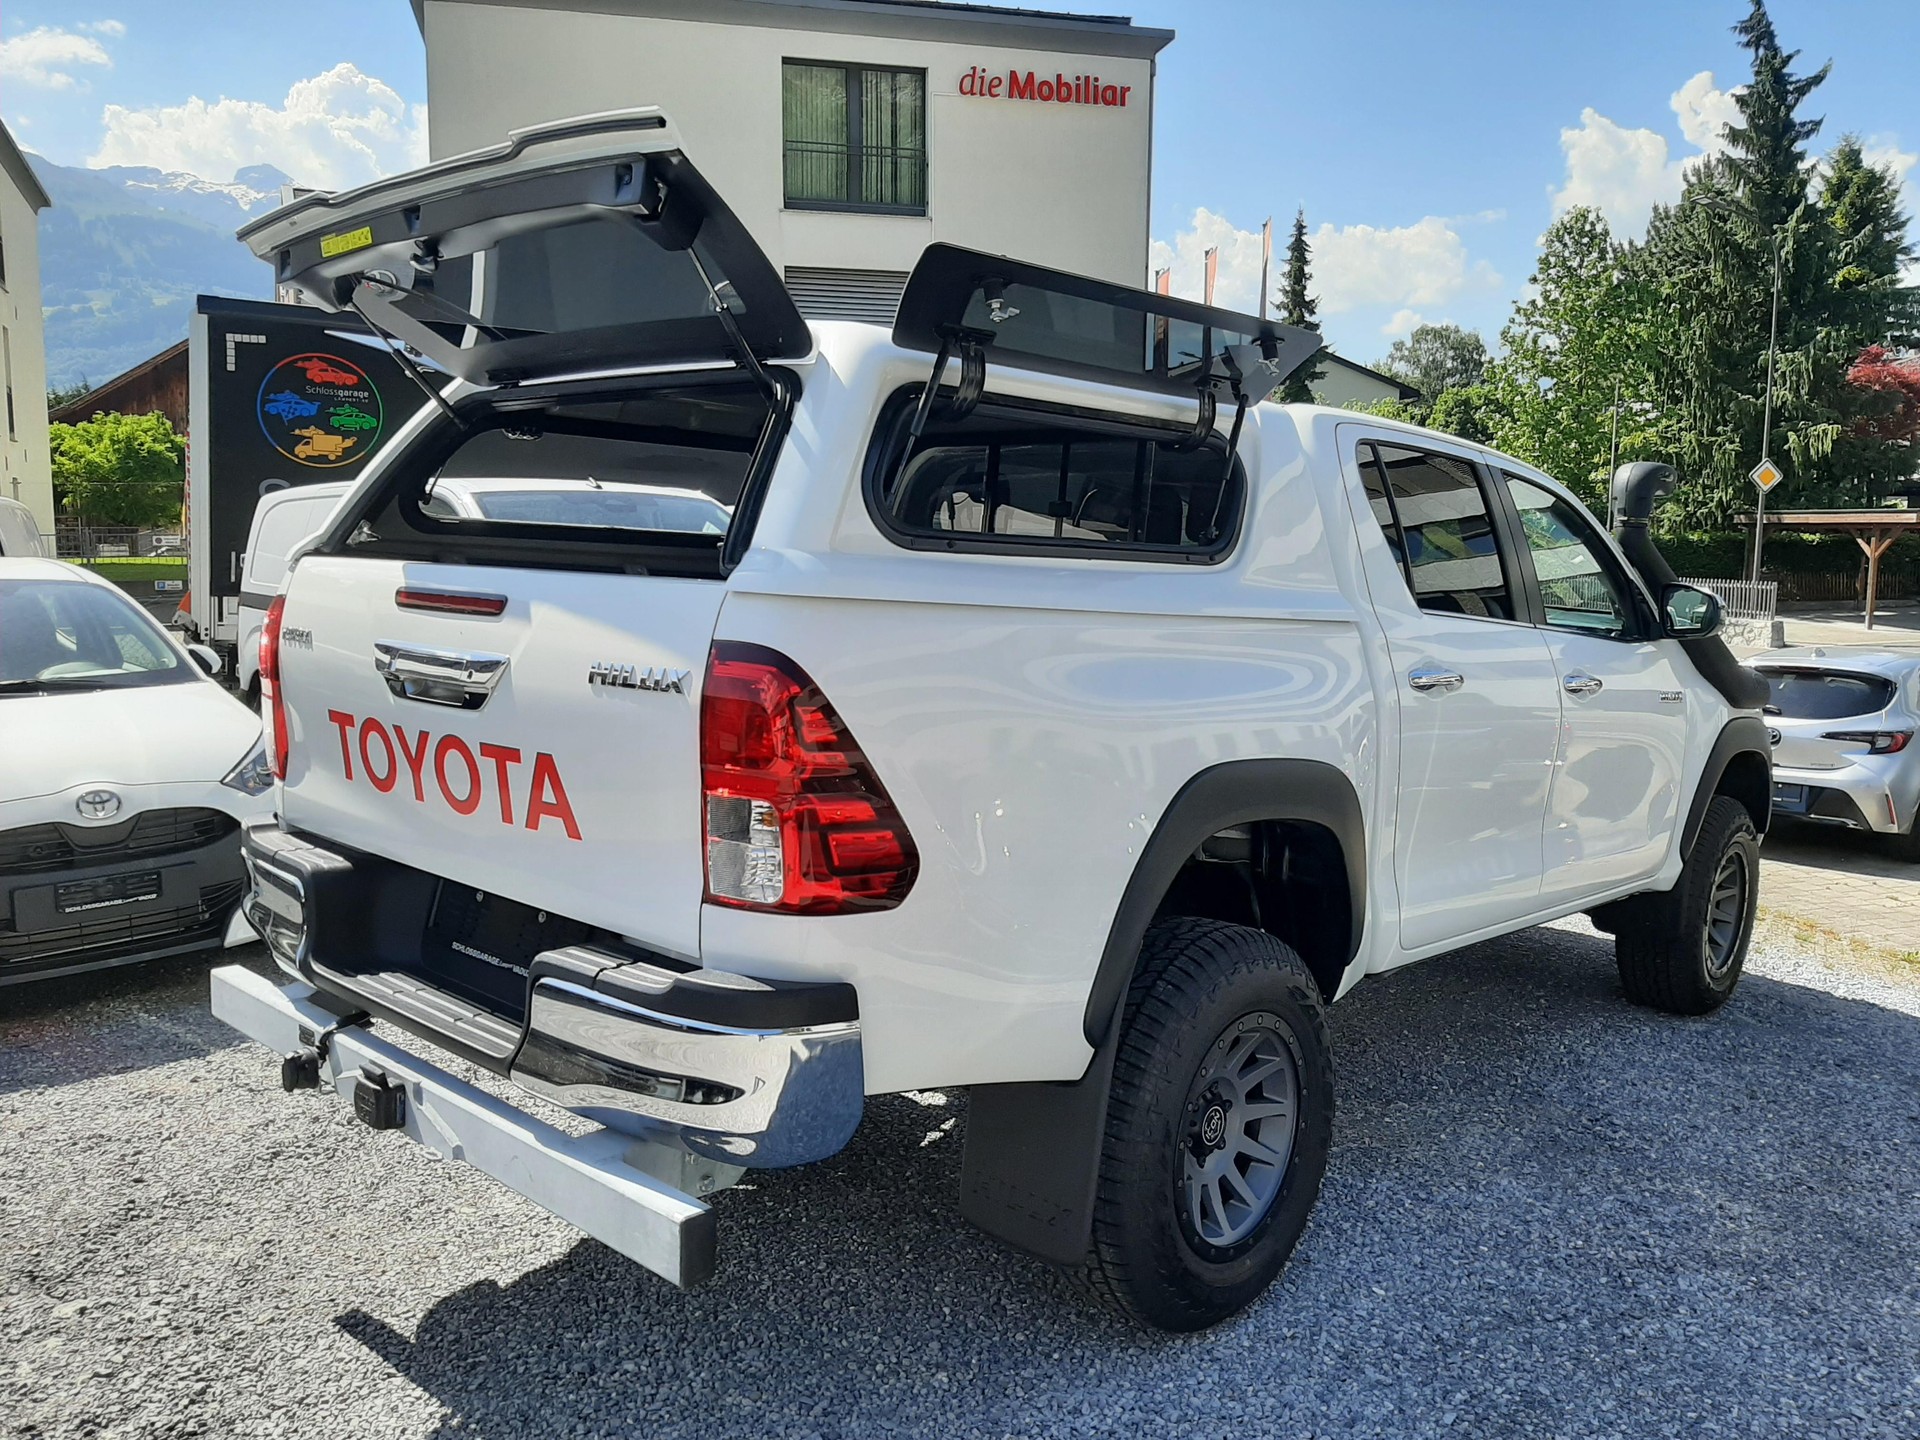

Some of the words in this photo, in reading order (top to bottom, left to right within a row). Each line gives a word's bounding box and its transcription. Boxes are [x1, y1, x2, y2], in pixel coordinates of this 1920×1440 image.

[959, 66, 1002, 98] die
[1008, 70, 1131, 107] Mobiliar
[305, 385, 369, 399] Schlossgarage
[588, 661, 693, 697] HILUX
[328, 709, 583, 841] TOYOTA
